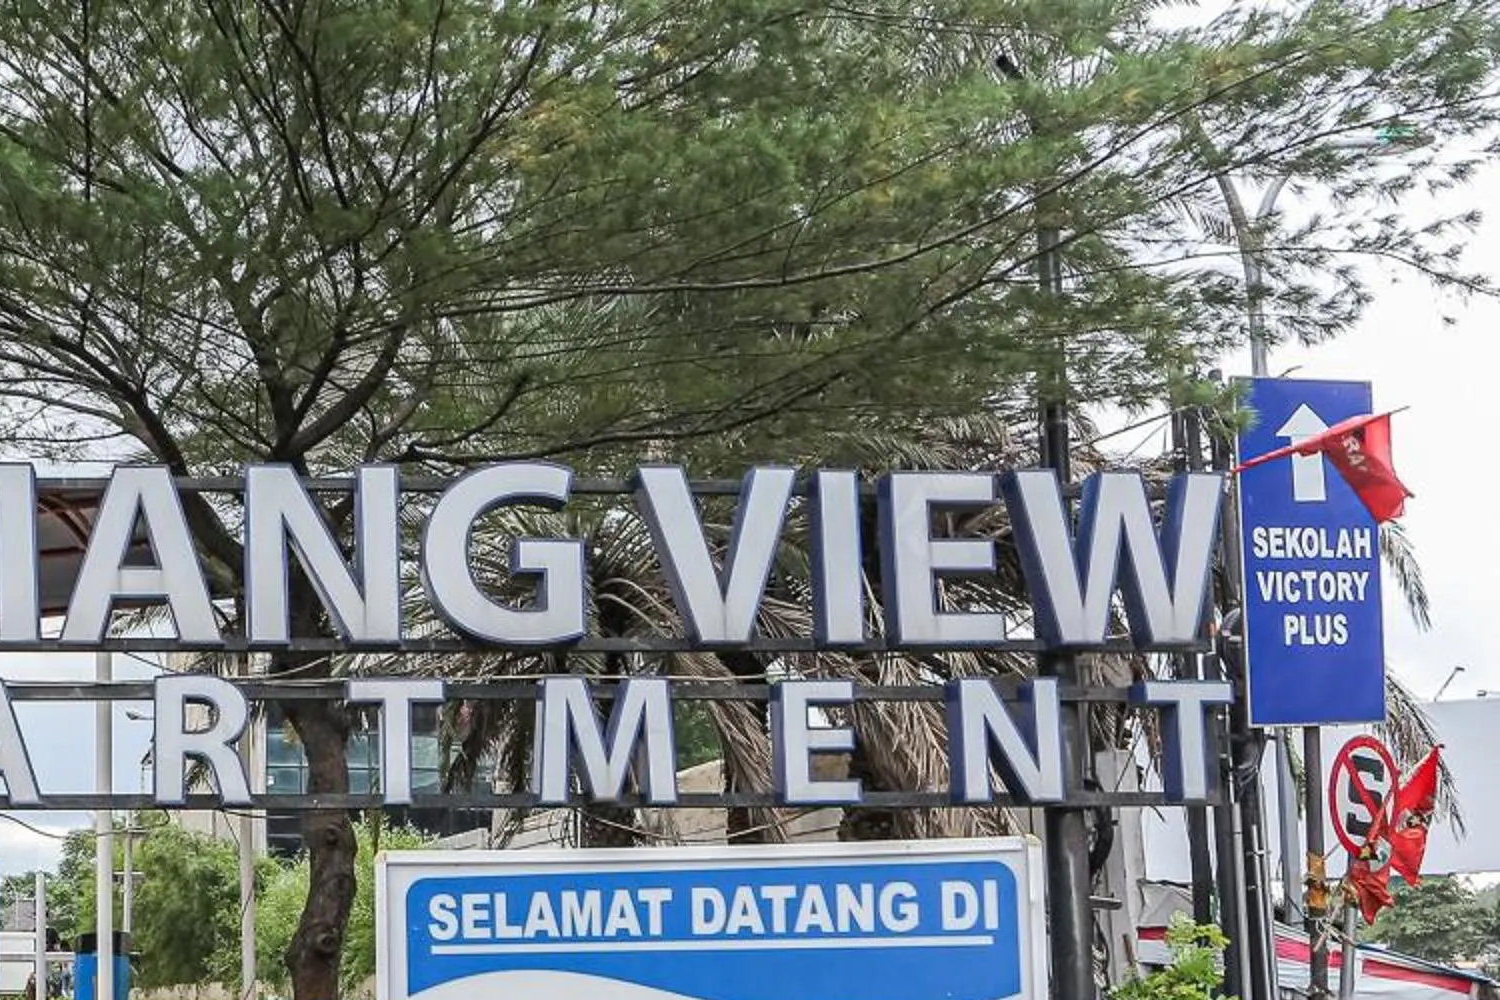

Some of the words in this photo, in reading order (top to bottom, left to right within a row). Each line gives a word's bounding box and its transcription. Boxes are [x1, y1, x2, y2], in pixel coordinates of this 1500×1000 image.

[636, 464, 1225, 649] VIEW
[1252, 527, 1372, 558] SEKOLAH
[1256, 570, 1369, 602] VICTORY
[1284, 613, 1348, 646] PLUS
[427, 888, 673, 941] SELAMAT
[692, 882, 919, 936] DATANG
[941, 879, 999, 931] DI
